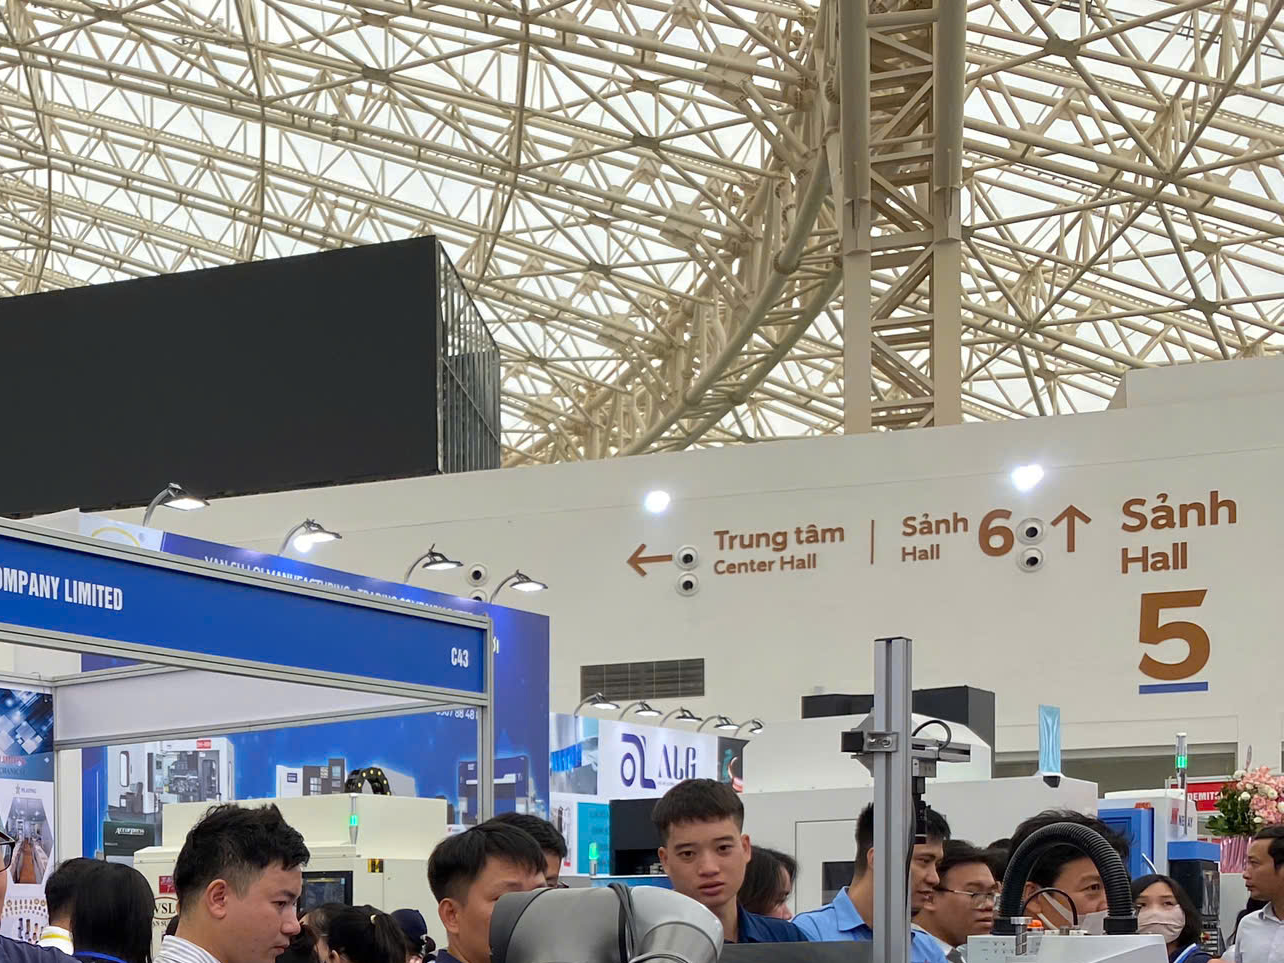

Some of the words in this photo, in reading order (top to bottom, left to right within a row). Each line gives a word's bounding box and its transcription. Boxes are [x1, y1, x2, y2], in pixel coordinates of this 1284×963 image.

[1121, 490, 1237, 532] Sảnh
[713, 530, 788, 552] Trung
[794, 524, 845, 545] tâm
[901, 512, 969, 537] Sảnh
[978, 509, 1015, 557] 6
[714, 559, 776, 575] Center
[780, 553, 817, 570] Hall
[901, 544, 940, 562] Hall
[1121, 542, 1188, 574] Hall
[64, 578, 123, 611] LIMITED
[1138, 588, 1211, 681] 5
[451, 647, 469, 668] C43
[1187, 791, 1221, 801] DEMITS
